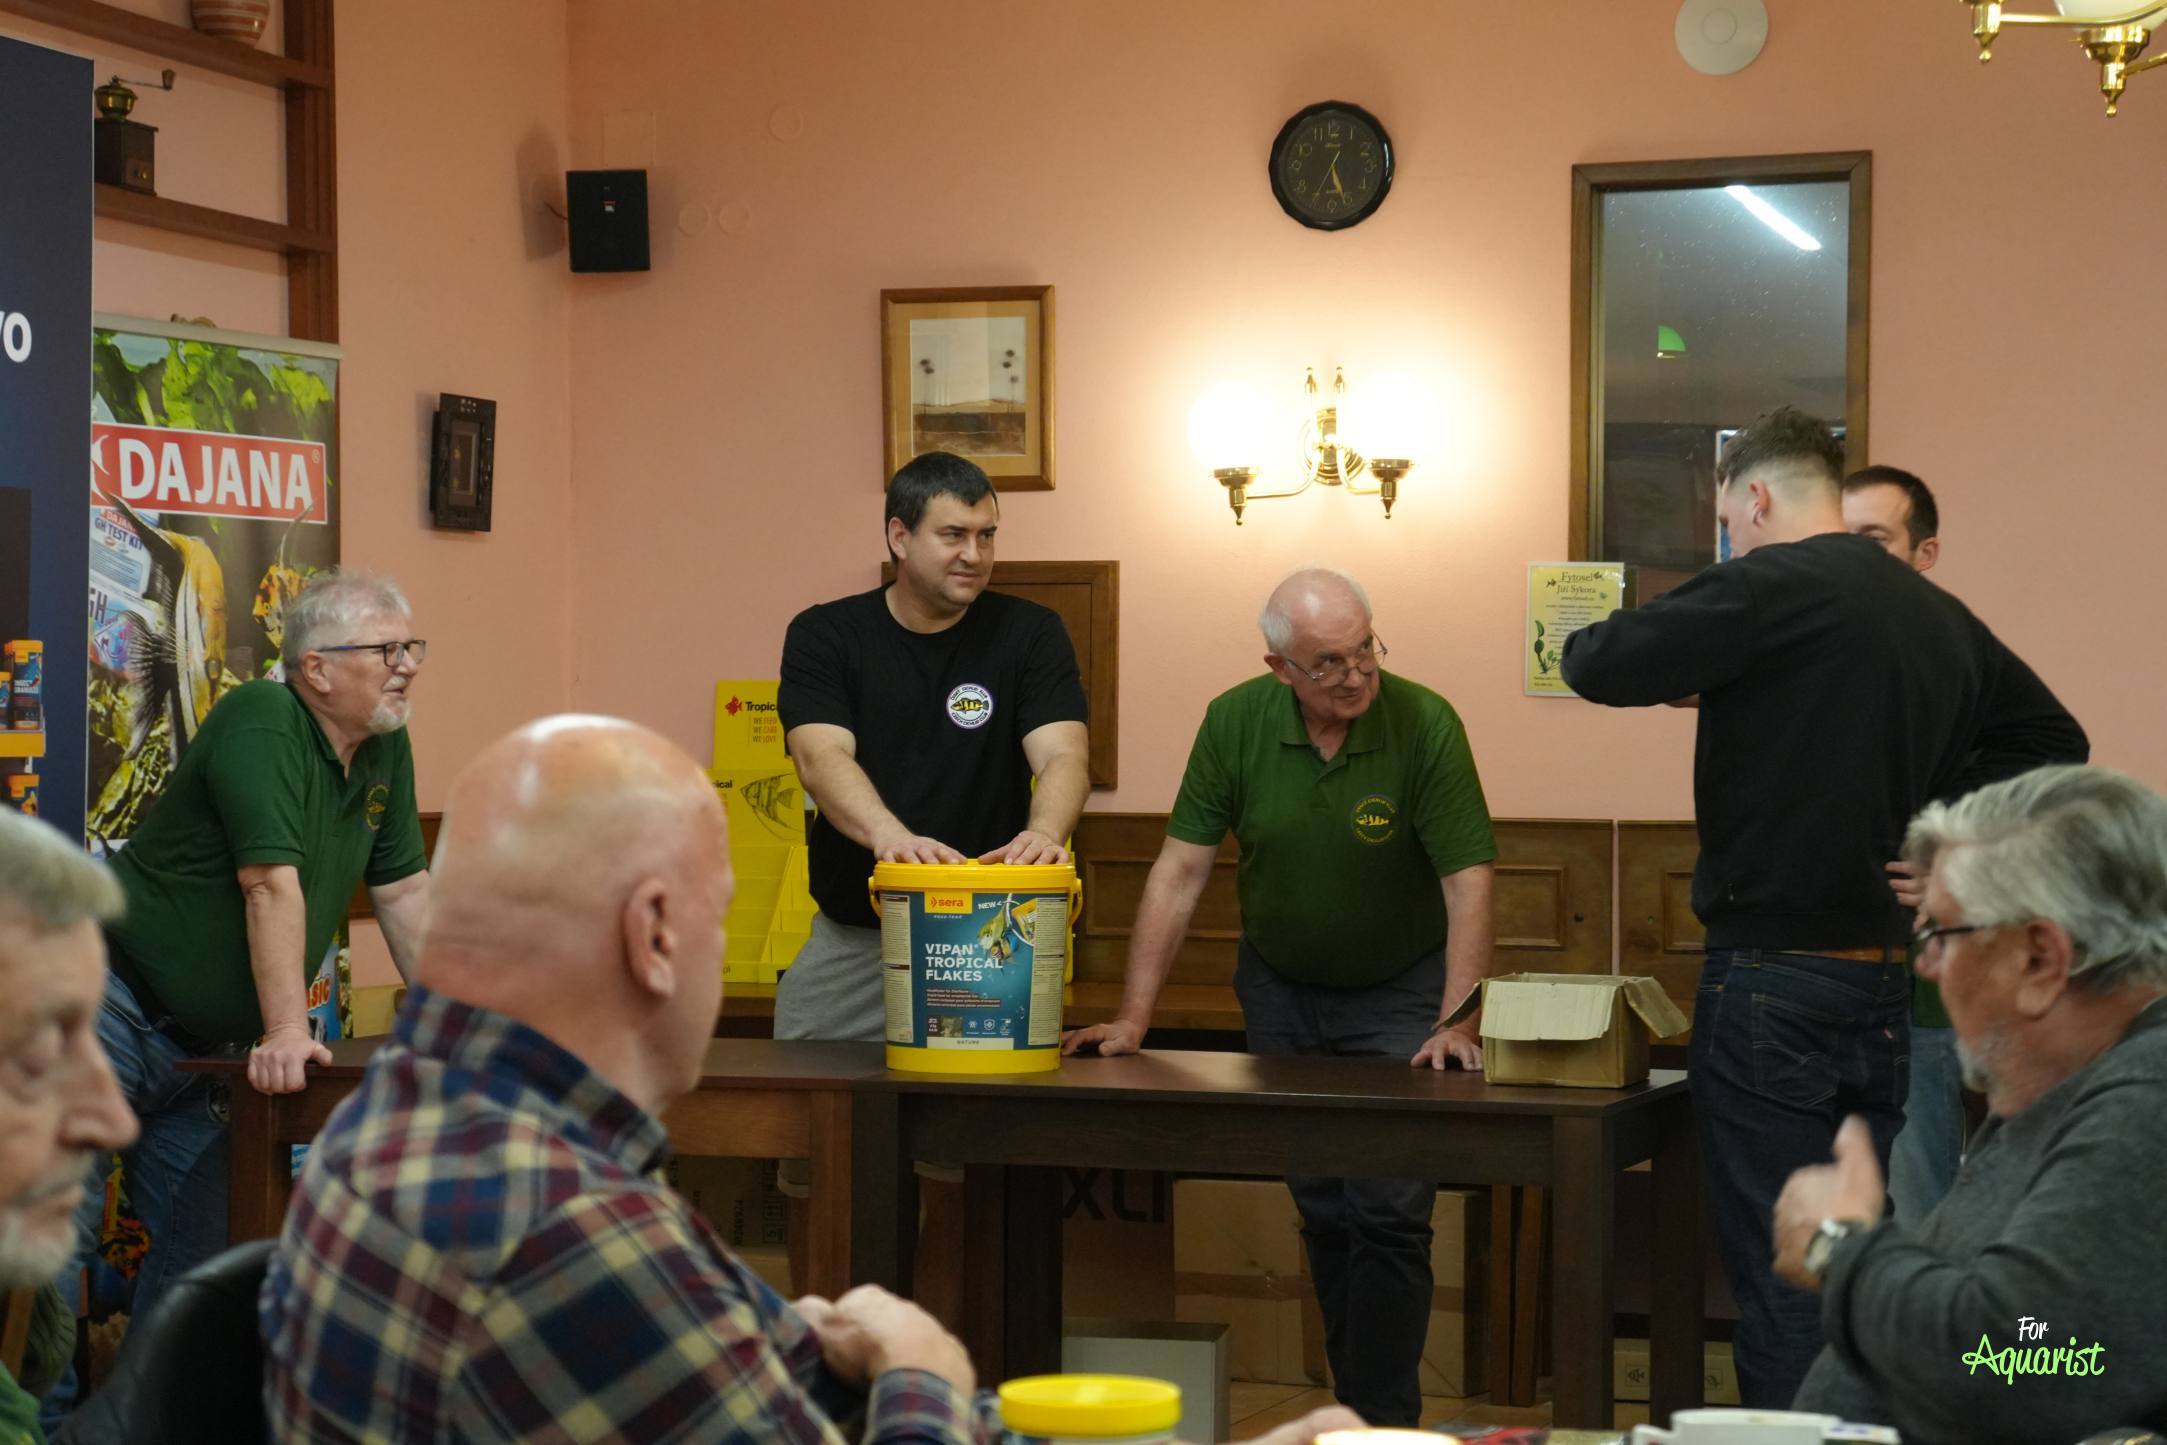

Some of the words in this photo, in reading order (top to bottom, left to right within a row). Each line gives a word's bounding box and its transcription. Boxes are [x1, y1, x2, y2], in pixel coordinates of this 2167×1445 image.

[118, 438, 314, 511] DAJANA
[108, 523, 128, 543] TEST
[128, 535, 144, 551] KIT
[745, 701, 777, 712] Tropic
[753, 735, 761, 743] WE
[938, 899, 964, 908] sera
[978, 901, 996, 910] NEW
[925, 956, 1004, 969] TROPICAL
[925, 969, 983, 982] FLAKES
